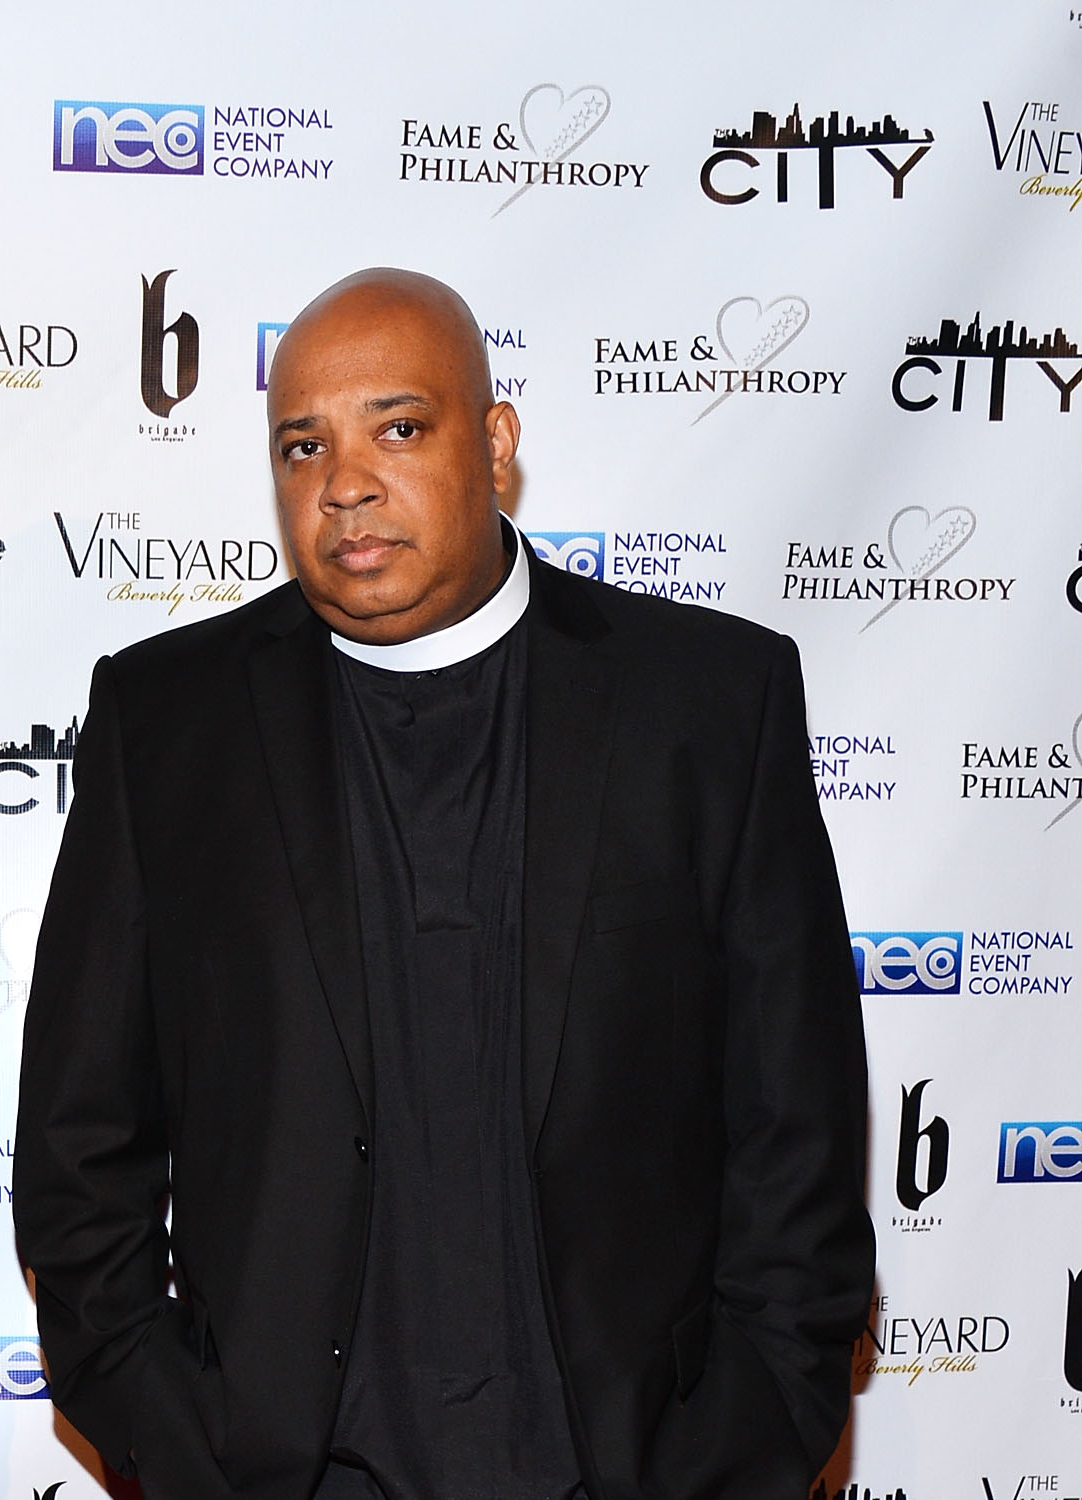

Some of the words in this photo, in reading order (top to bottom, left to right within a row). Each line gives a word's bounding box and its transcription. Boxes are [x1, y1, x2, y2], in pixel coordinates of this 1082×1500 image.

[213, 106, 333, 130] NATIONAL
[1031, 103, 1059, 122] THE
[213, 131, 284, 154] EVENT
[401, 119, 482, 151] FAME
[493, 123, 519, 150] &
[212, 155, 334, 180] COMPANY
[399, 154, 650, 189] PHILANTHROPY
[700, 147, 932, 209] CITY
[594, 337, 678, 363] FAME
[690, 335, 717, 361] &
[594, 370, 847, 395] PHILANTHROPY
[891, 355, 1082, 421] CITY
[139, 423, 197, 437] brigade
[106, 513, 140, 530] THE
[54, 512, 277, 581] VINEYARD
[614, 533, 727, 553] NATIONAL
[614, 557, 681, 576] EVENT
[787, 543, 853, 568] FAME
[863, 543, 887, 569] &
[107, 582, 186, 615] Beverly
[192, 583, 243, 603] Hills
[782, 574, 1016, 601] PHILANTHROPY
[962, 744, 1038, 768] FAME
[1048, 744, 1071, 768] &
[812, 760, 849, 777] ENT
[818, 782, 897, 800] MPANY
[960, 775, 1082, 798] PHILANT
[971, 931, 1073, 950] NATIONAL
[971, 954, 1031, 972] EVENT
[969, 976, 1073, 995] COMPANY
[855, 1356, 924, 1386] Beverly
[928, 1355, 978, 1374] Hills
[1028, 1475, 1058, 1491] THE
